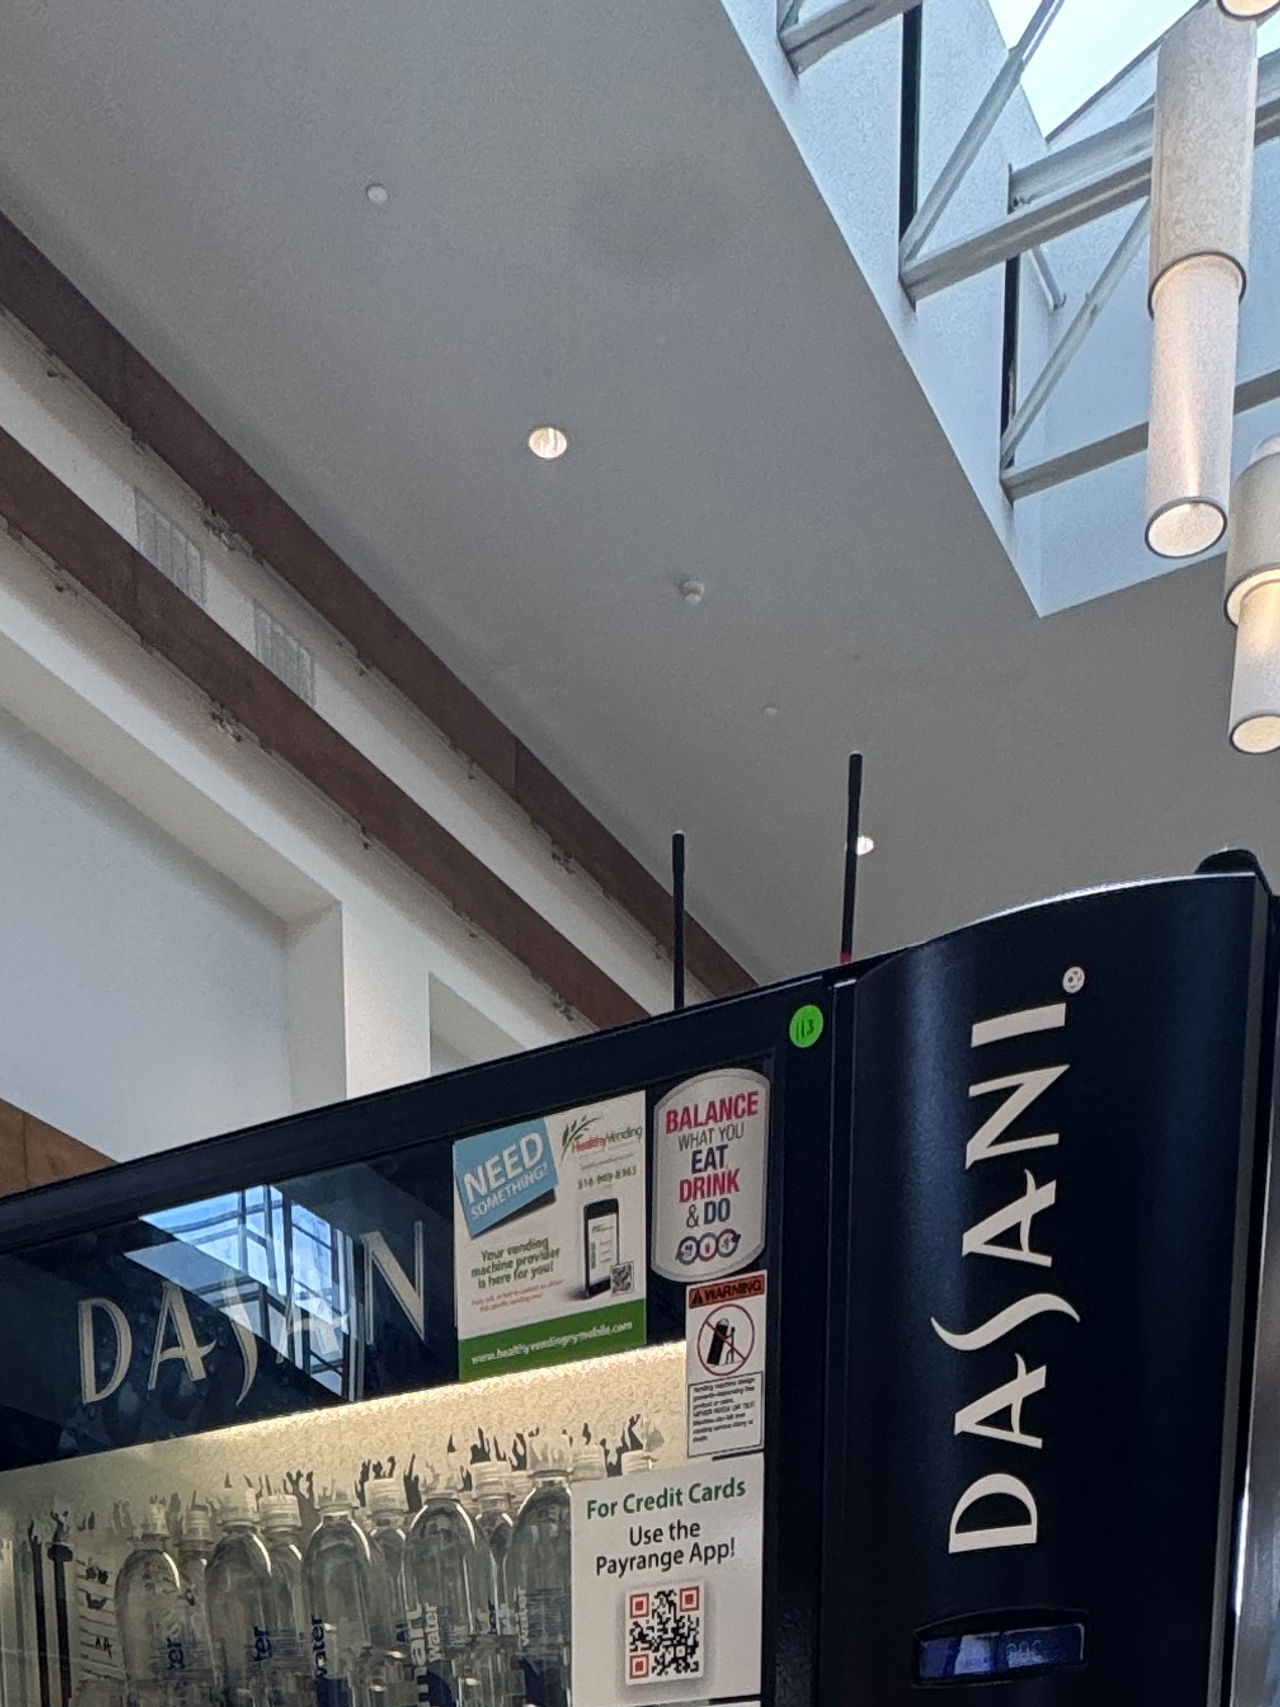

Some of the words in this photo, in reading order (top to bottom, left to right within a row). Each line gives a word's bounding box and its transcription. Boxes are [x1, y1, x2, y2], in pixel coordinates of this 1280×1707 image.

[666, 1091, 759, 1134] BALANCE
[678, 1127, 715, 1151] WHAT
[719, 1122, 744, 1142] YOU
[464, 1132, 543, 1203] NEED
[691, 1145, 728, 1174] EAT
[679, 1168, 740, 1203] DRINK
[686, 1204, 699, 1229] &
[704, 1198, 730, 1225] DO
[471, 1259, 513, 1277] machine
[515, 1248, 560, 1269] provider
[481, 1247, 504, 1262] Your
[506, 1237, 550, 1256] vending
[478, 1277, 486, 1289] is
[489, 1272, 511, 1287] here
[513, 1265, 529, 1281] for
[530, 1260, 554, 1281] you!
[931, 1002, 1080, 1555] DASANI
[704, 1279, 762, 1301] WARNING
[587, 1500, 618, 1520] For
[623, 1487, 683, 1514] Credit
[689, 1477, 746, 1503] Cards
[629, 1525, 663, 1546] Use
[669, 1519, 701, 1543] the
[596, 1549, 684, 1579] Payrange
[689, 1537, 735, 1566] App!
